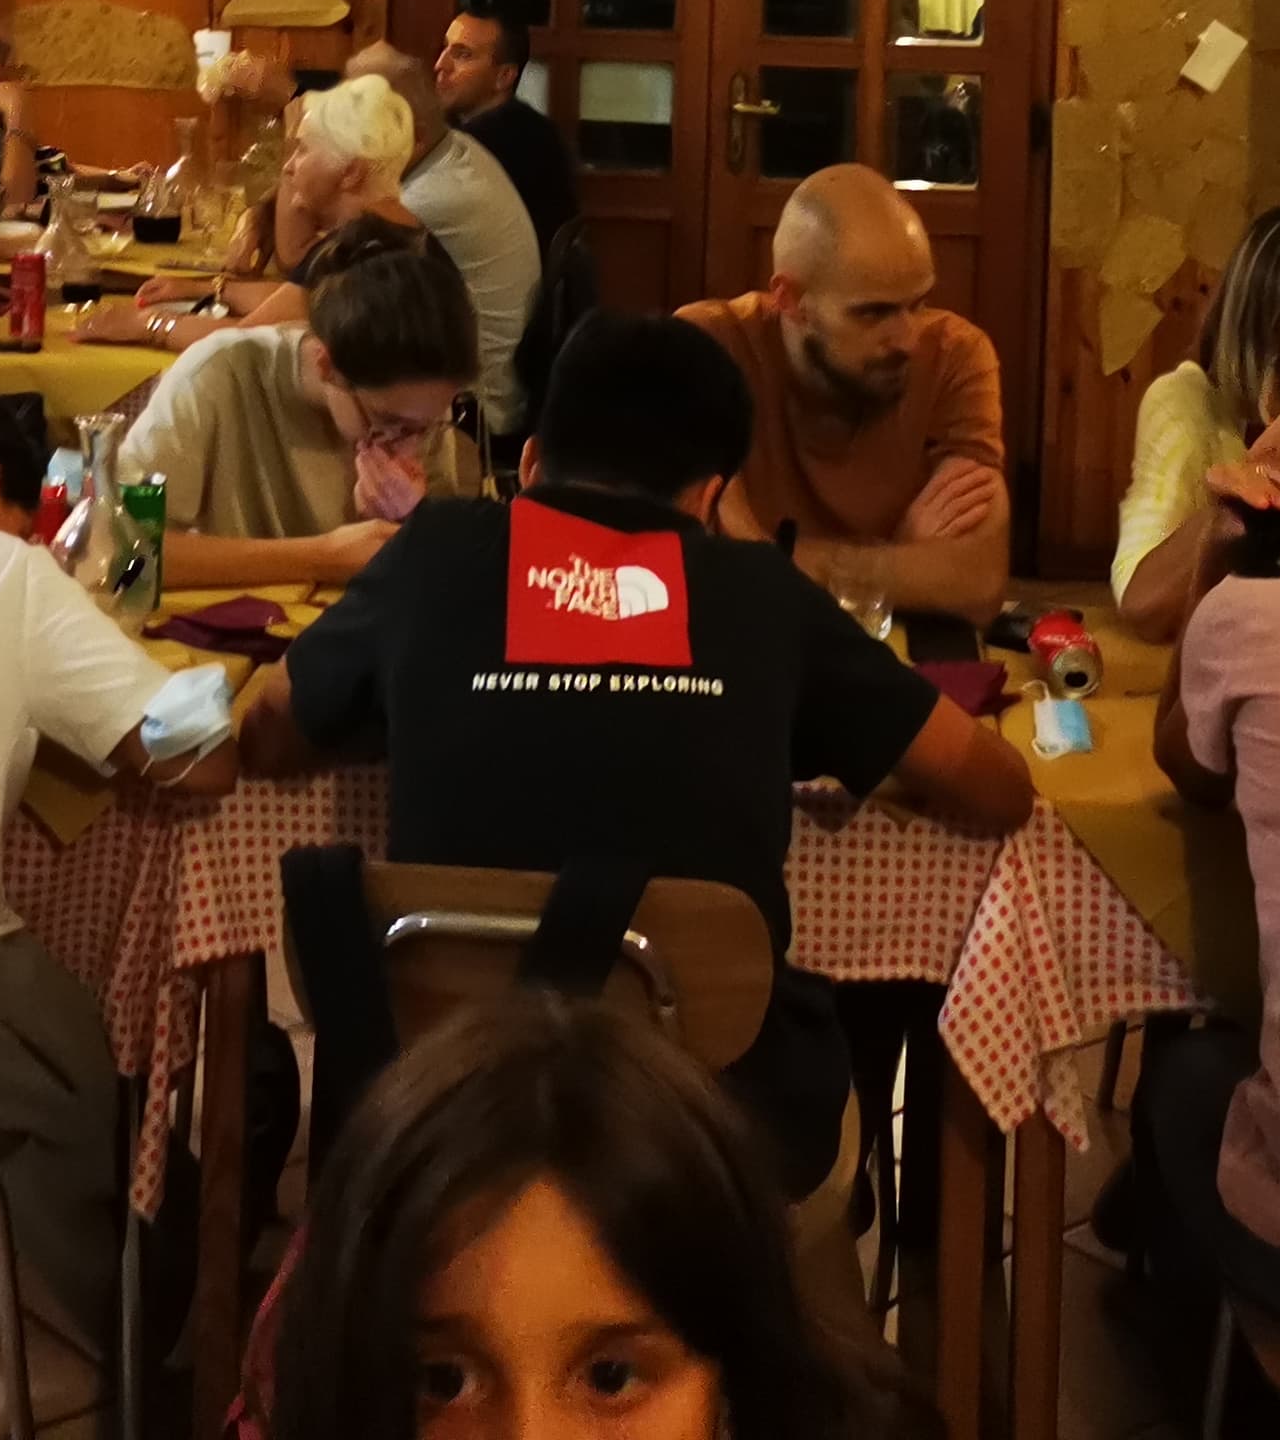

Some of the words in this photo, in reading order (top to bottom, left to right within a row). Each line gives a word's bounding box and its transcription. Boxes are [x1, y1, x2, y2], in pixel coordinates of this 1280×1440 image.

[567, 553, 617, 585] THE
[527, 565, 619, 608] NORTH
[553, 585, 619, 621] FACE
[472, 672, 539, 691] NEVER
[548, 672, 602, 692] STOP
[610, 673, 724, 696] EXPLORING
